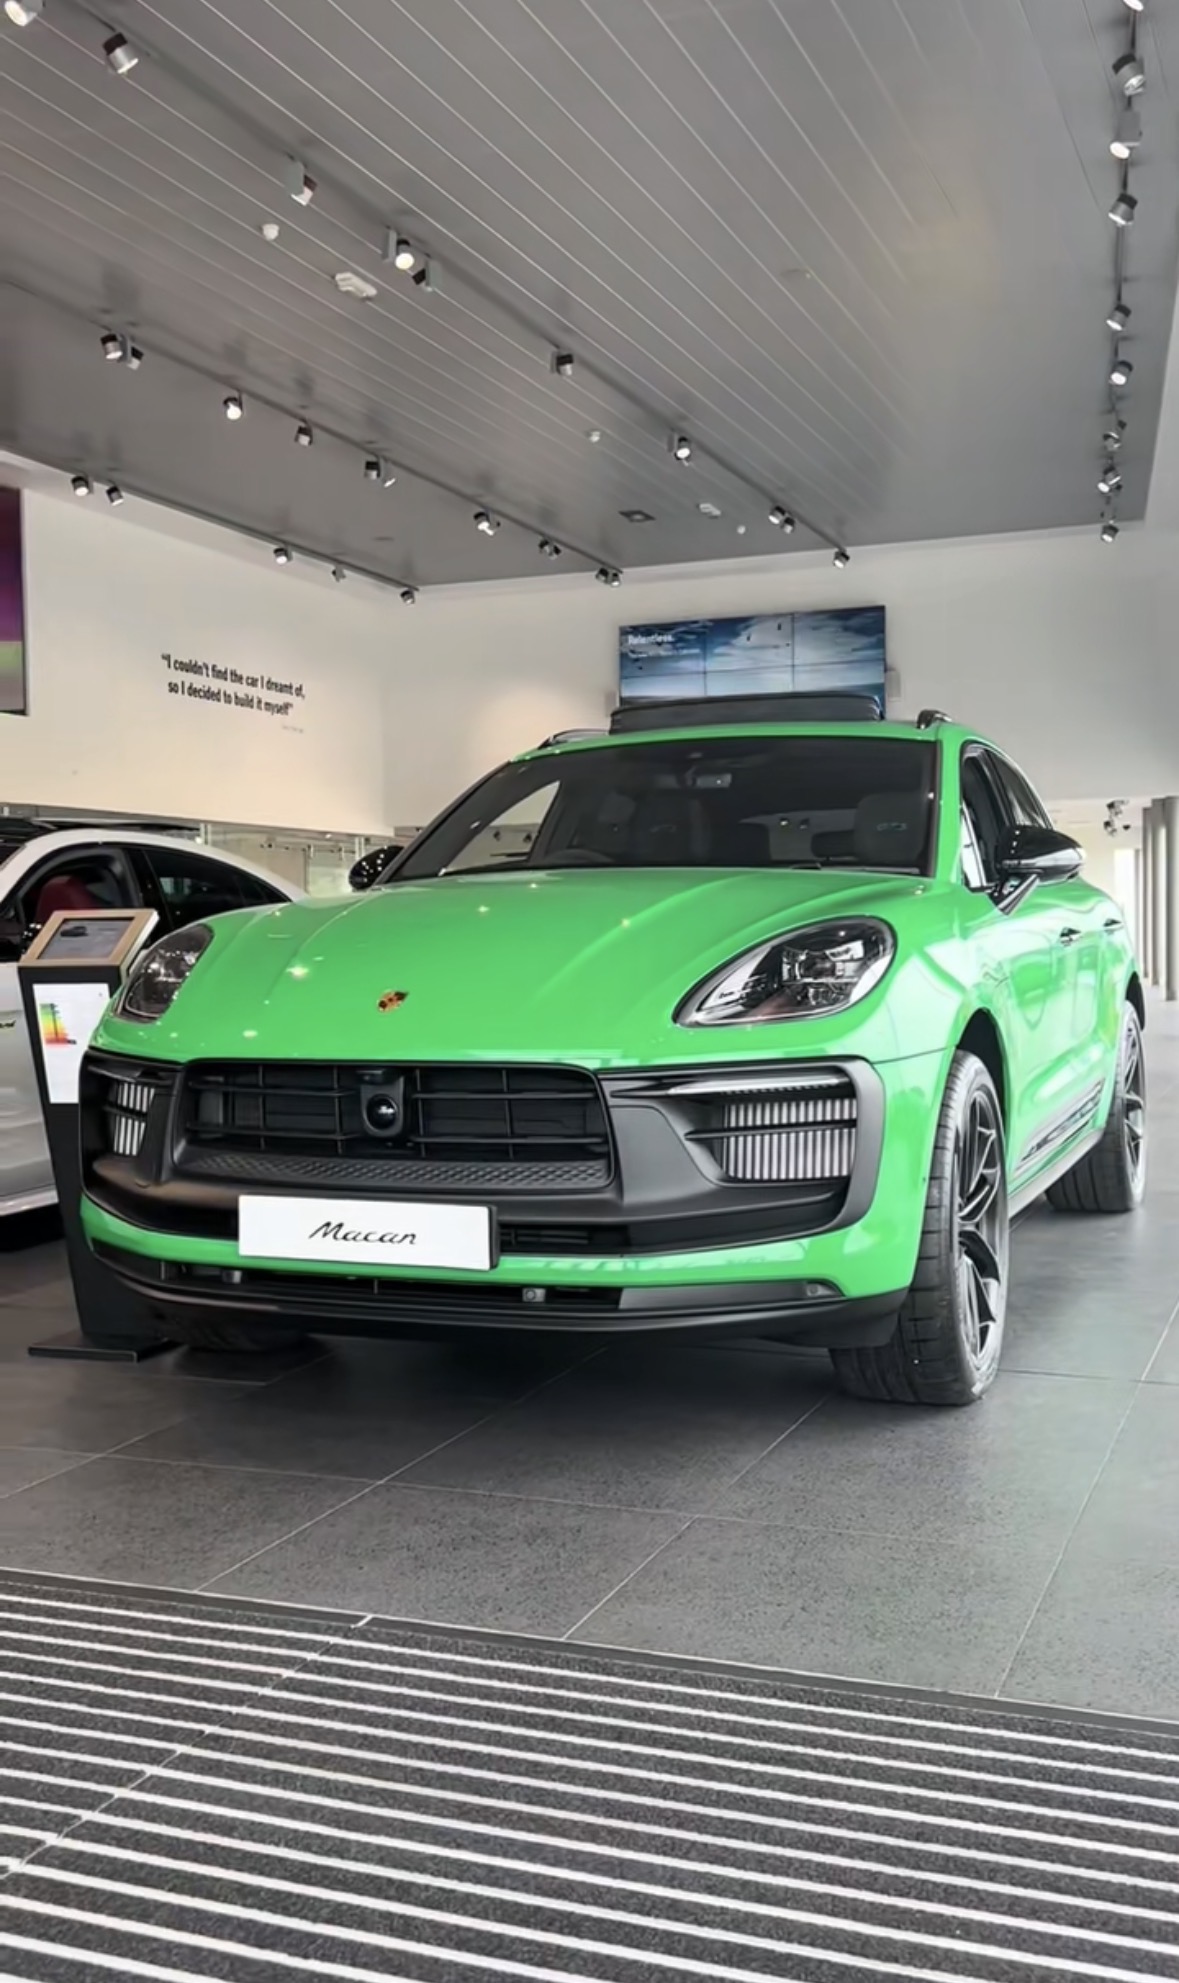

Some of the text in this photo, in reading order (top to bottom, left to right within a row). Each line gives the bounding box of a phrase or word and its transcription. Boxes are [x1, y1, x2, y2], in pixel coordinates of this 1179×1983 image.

[173, 659, 209, 678] couldn’t
[211, 664, 228, 681] find
[230, 669, 243, 685] the
[245, 676, 259, 688] car
[260, 675, 264, 689] I
[266, 677, 293, 696] dreamt
[168, 681, 179, 694] so
[181, 680, 186, 695] I
[187, 682, 221, 703] decided
[223, 690, 233, 705] to
[234, 691, 254, 709] build
[256, 695, 262, 711] it
[308, 1221, 416, 1245] Macan
